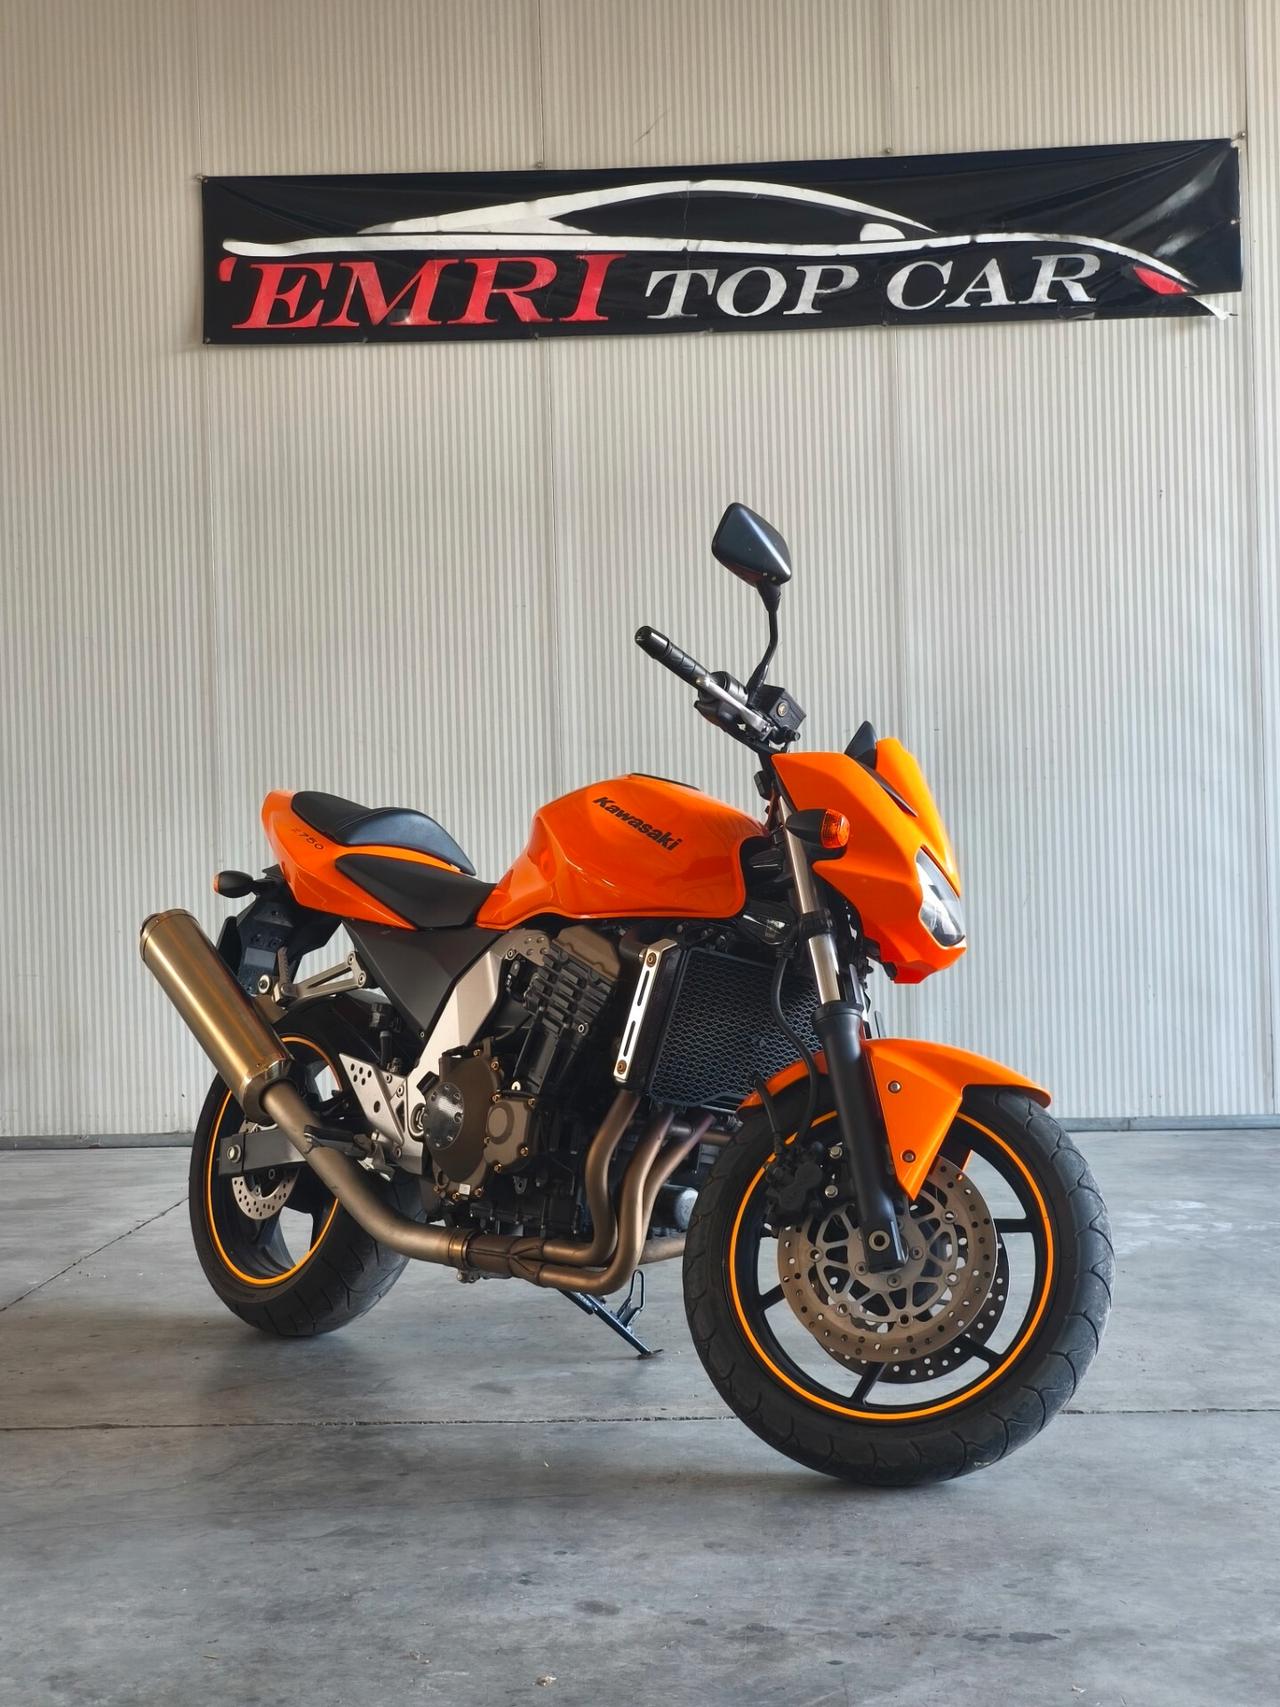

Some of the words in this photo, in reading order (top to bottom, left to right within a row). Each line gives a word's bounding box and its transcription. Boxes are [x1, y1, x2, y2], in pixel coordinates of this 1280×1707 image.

[232, 253, 626, 329] EMRI
[645, 265, 859, 319] TOP
[886, 253, 1100, 311] CAR
[593, 797, 682, 851] Kawasaki
